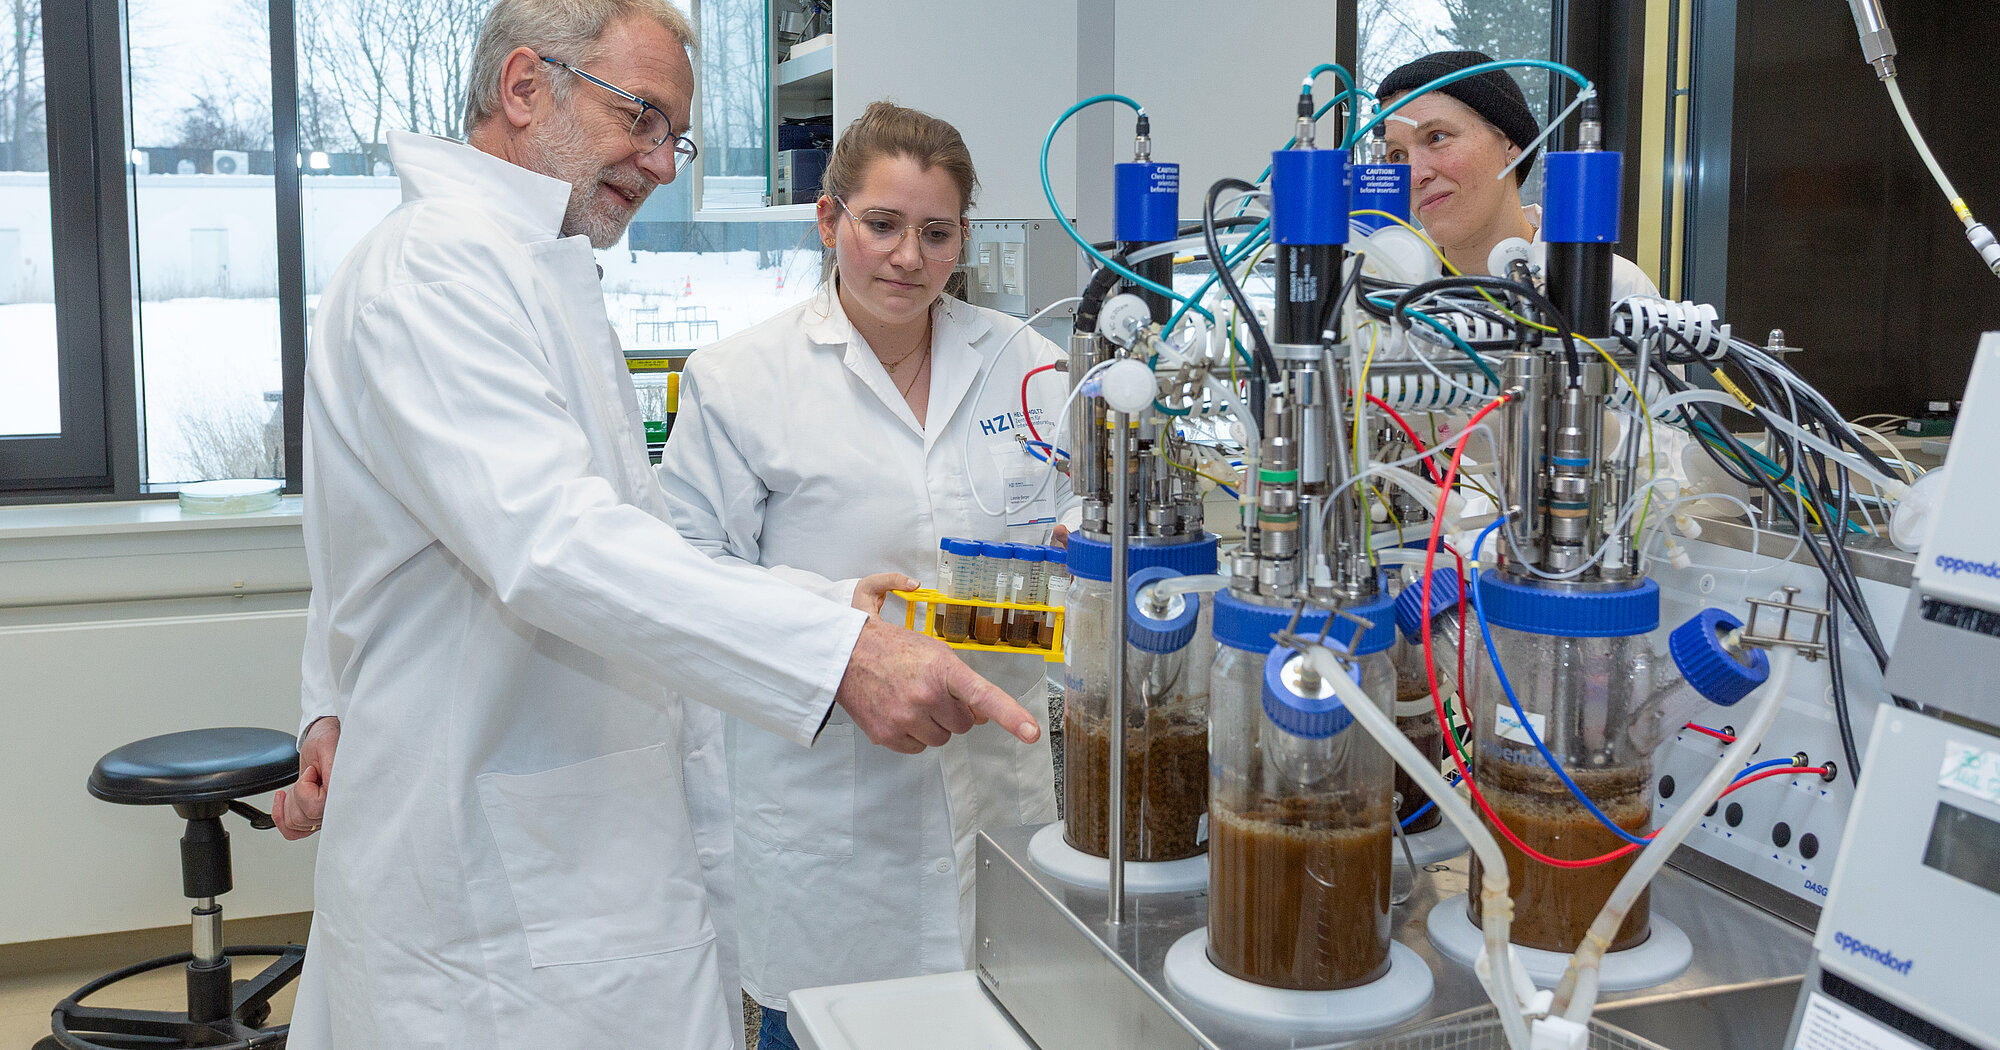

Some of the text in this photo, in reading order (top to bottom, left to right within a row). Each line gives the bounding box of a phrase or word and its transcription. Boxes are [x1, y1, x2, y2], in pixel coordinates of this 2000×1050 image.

[1013, 408, 1044, 417] HELHOLTZ
[1015, 416, 1035, 424] Zentm
[1834, 930, 1913, 976] eppendorf
